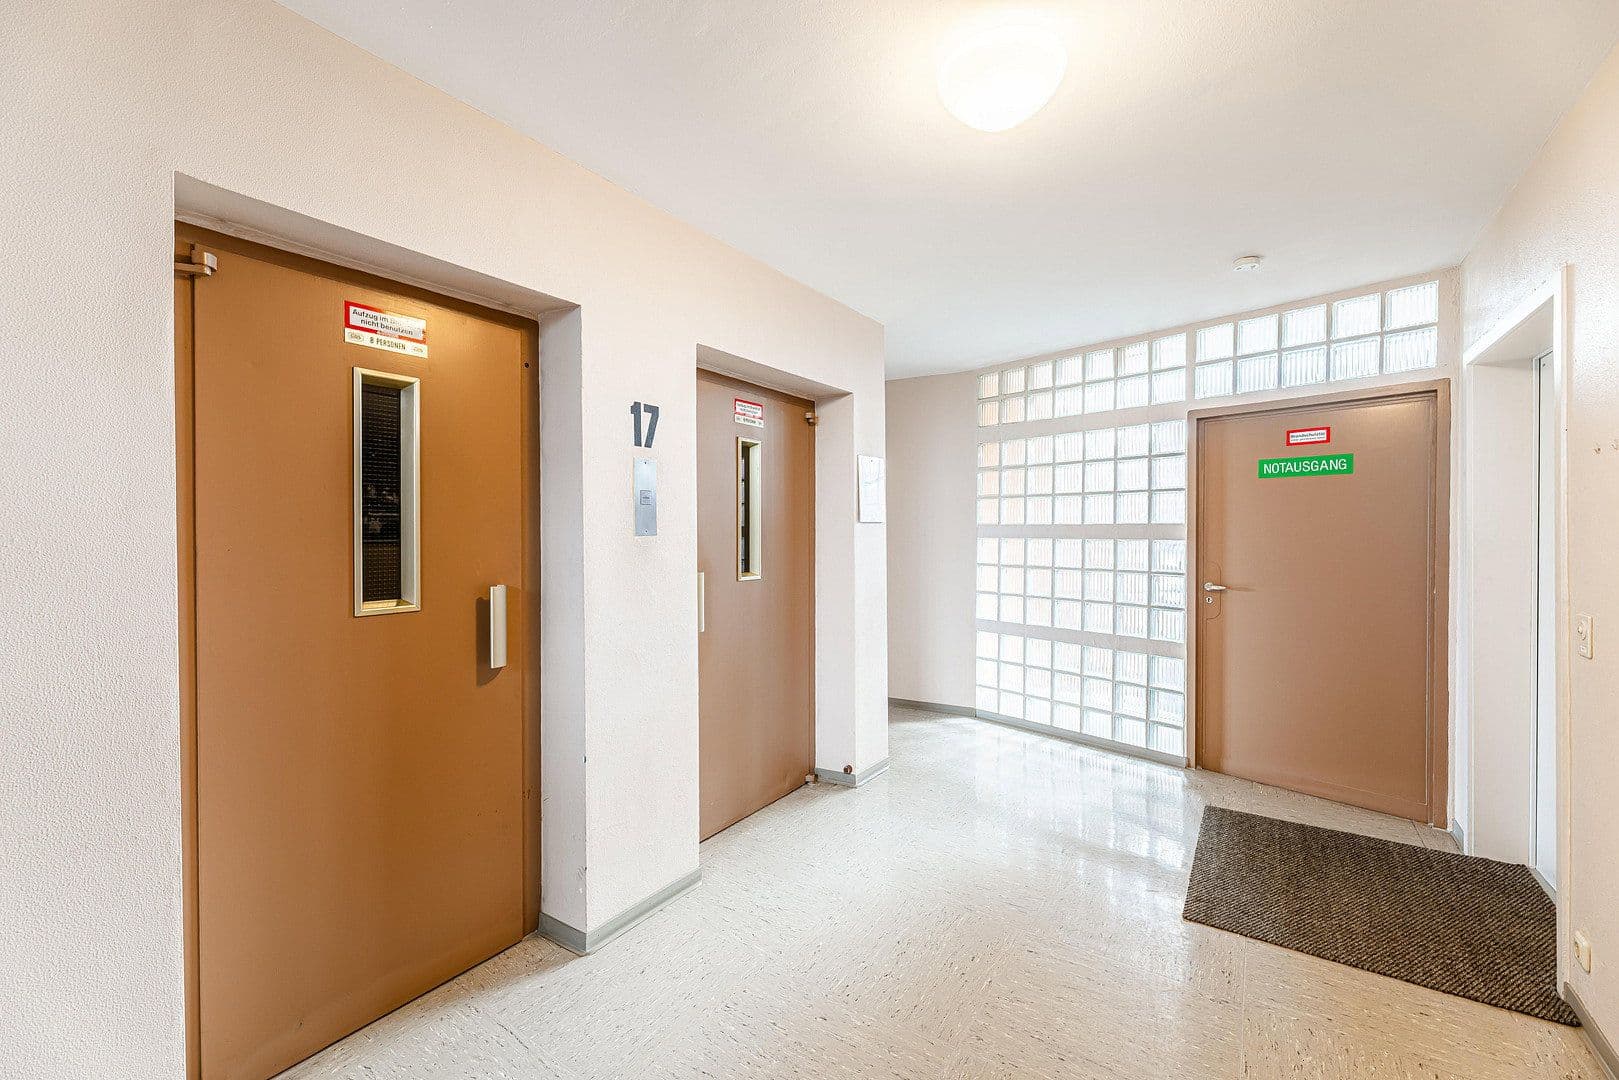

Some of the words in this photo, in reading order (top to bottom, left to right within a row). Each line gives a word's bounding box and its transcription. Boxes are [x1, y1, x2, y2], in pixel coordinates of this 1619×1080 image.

[352, 308, 378, 321] Aufzug
[379, 315, 389, 323] im
[360, 318, 379, 328] nicht
[380, 322, 413, 336] benutzen
[376, 337, 406, 350] PERSONEN
[630, 401, 660, 448] 17
[1263, 458, 1347, 474] NOTAUSGANG
